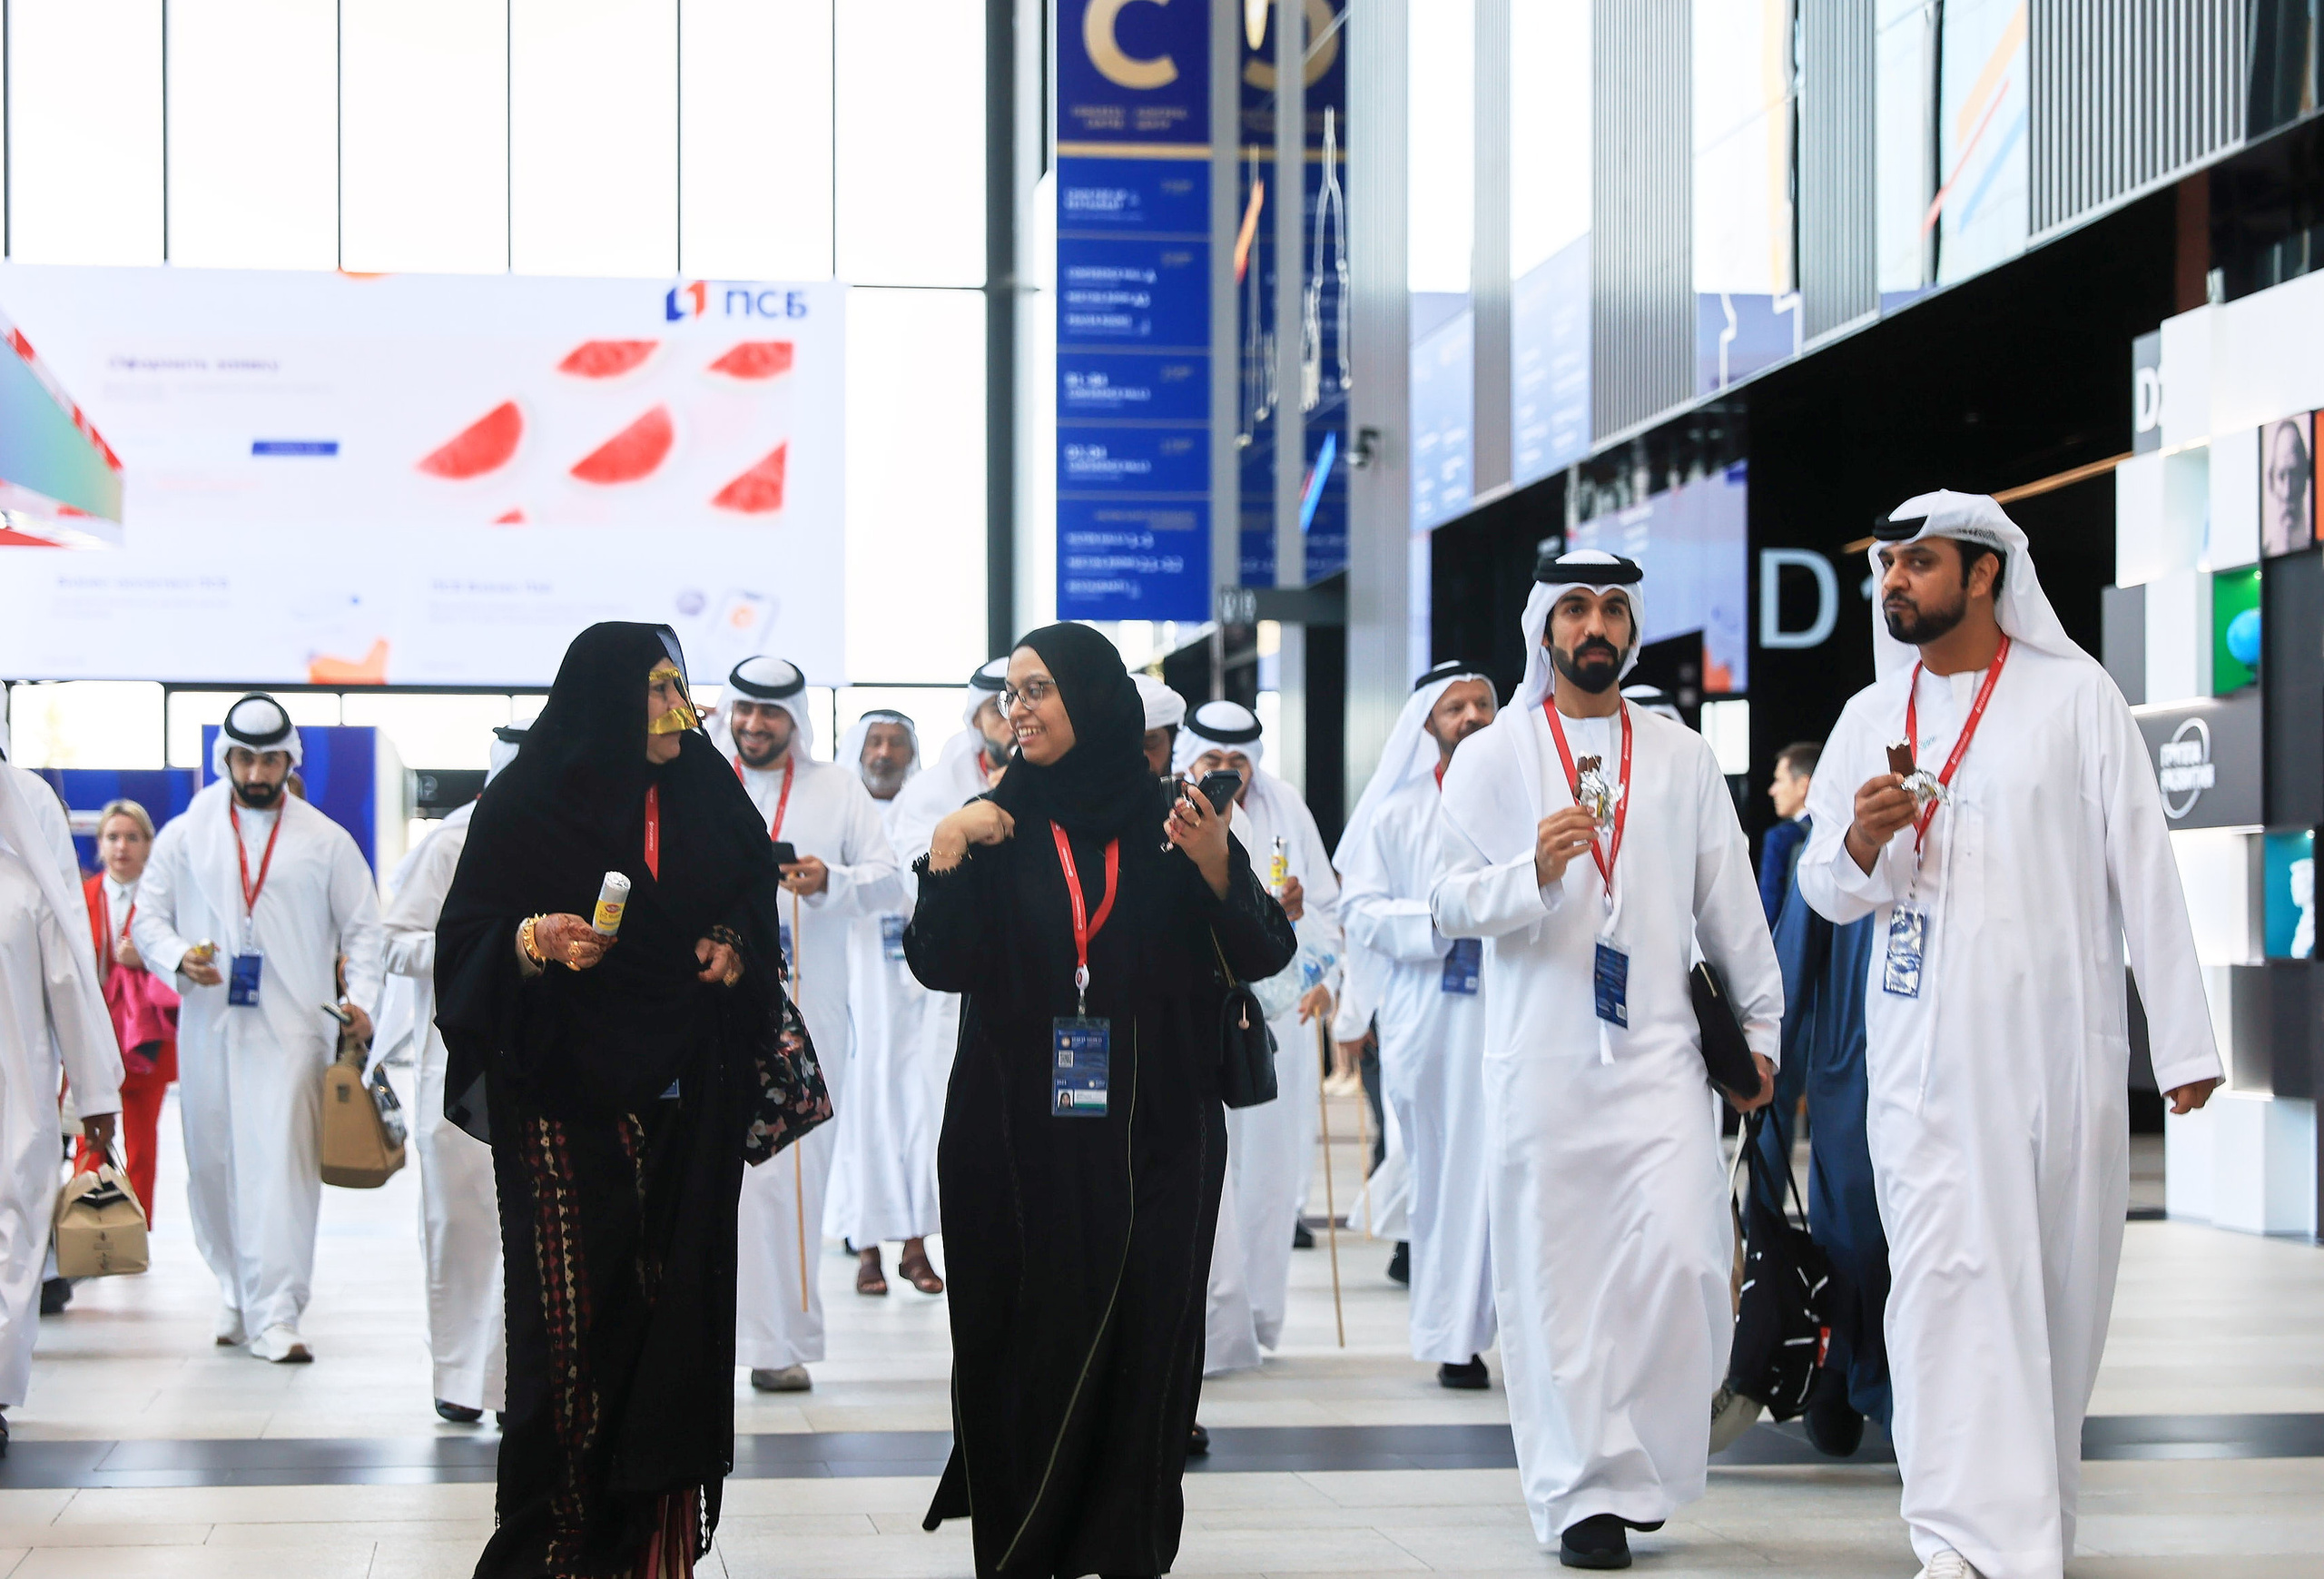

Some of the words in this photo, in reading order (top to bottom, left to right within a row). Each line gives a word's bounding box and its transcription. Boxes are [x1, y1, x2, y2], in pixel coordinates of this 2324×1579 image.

[1082, 0, 1178, 89] C
[726, 291, 807, 318] ПСБ
[2135, 363, 2162, 433] D
[1759, 547, 1873, 649] D
